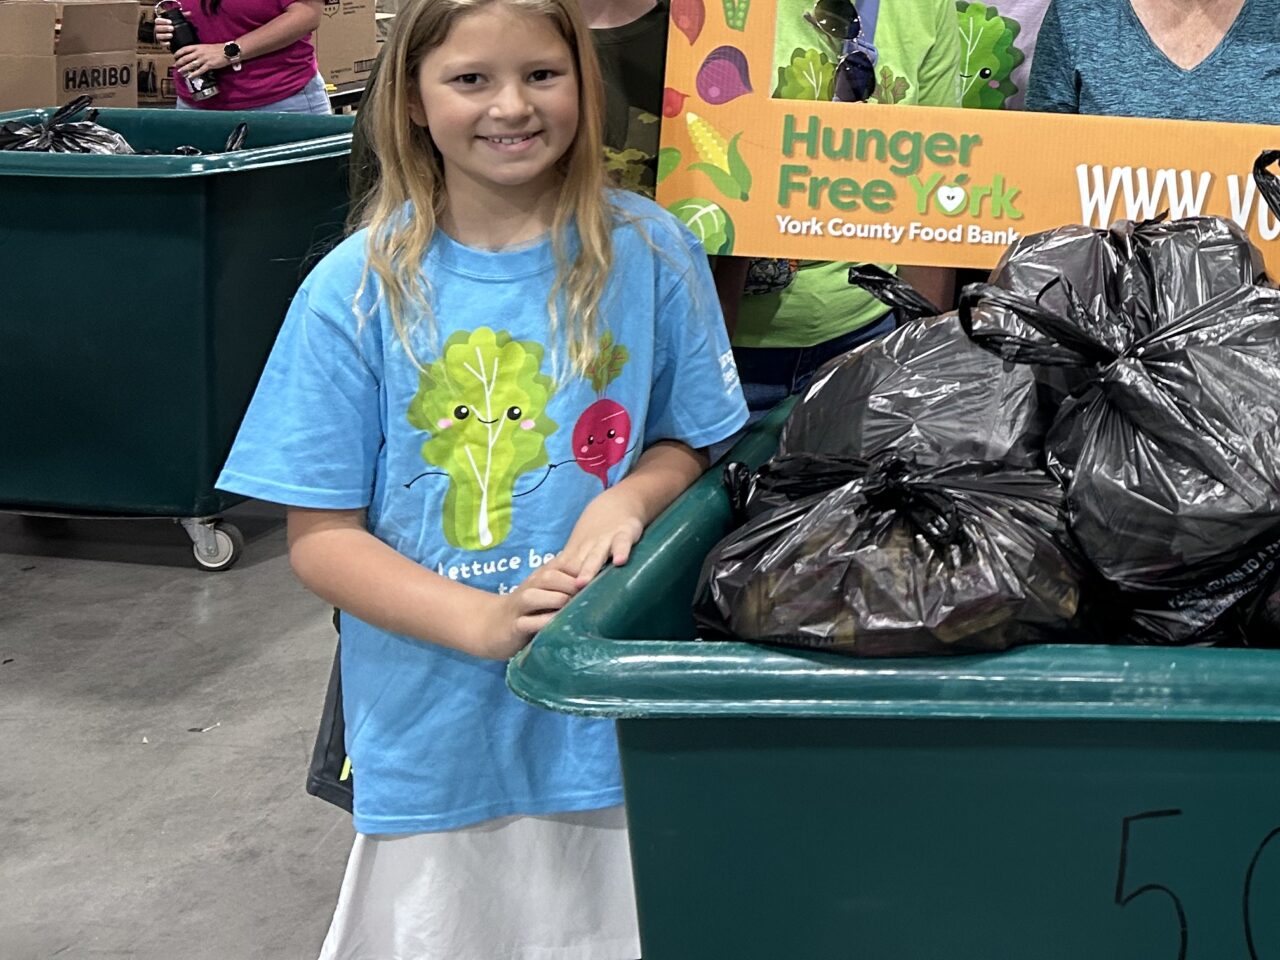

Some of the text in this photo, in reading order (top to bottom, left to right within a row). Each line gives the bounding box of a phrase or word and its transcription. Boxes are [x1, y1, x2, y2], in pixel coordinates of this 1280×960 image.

[65, 66, 131, 90] HARIBO
[781, 113, 981, 176] Hunger
[778, 164, 1023, 221] Free York
[776, 215, 1021, 246] York County Food Bank
